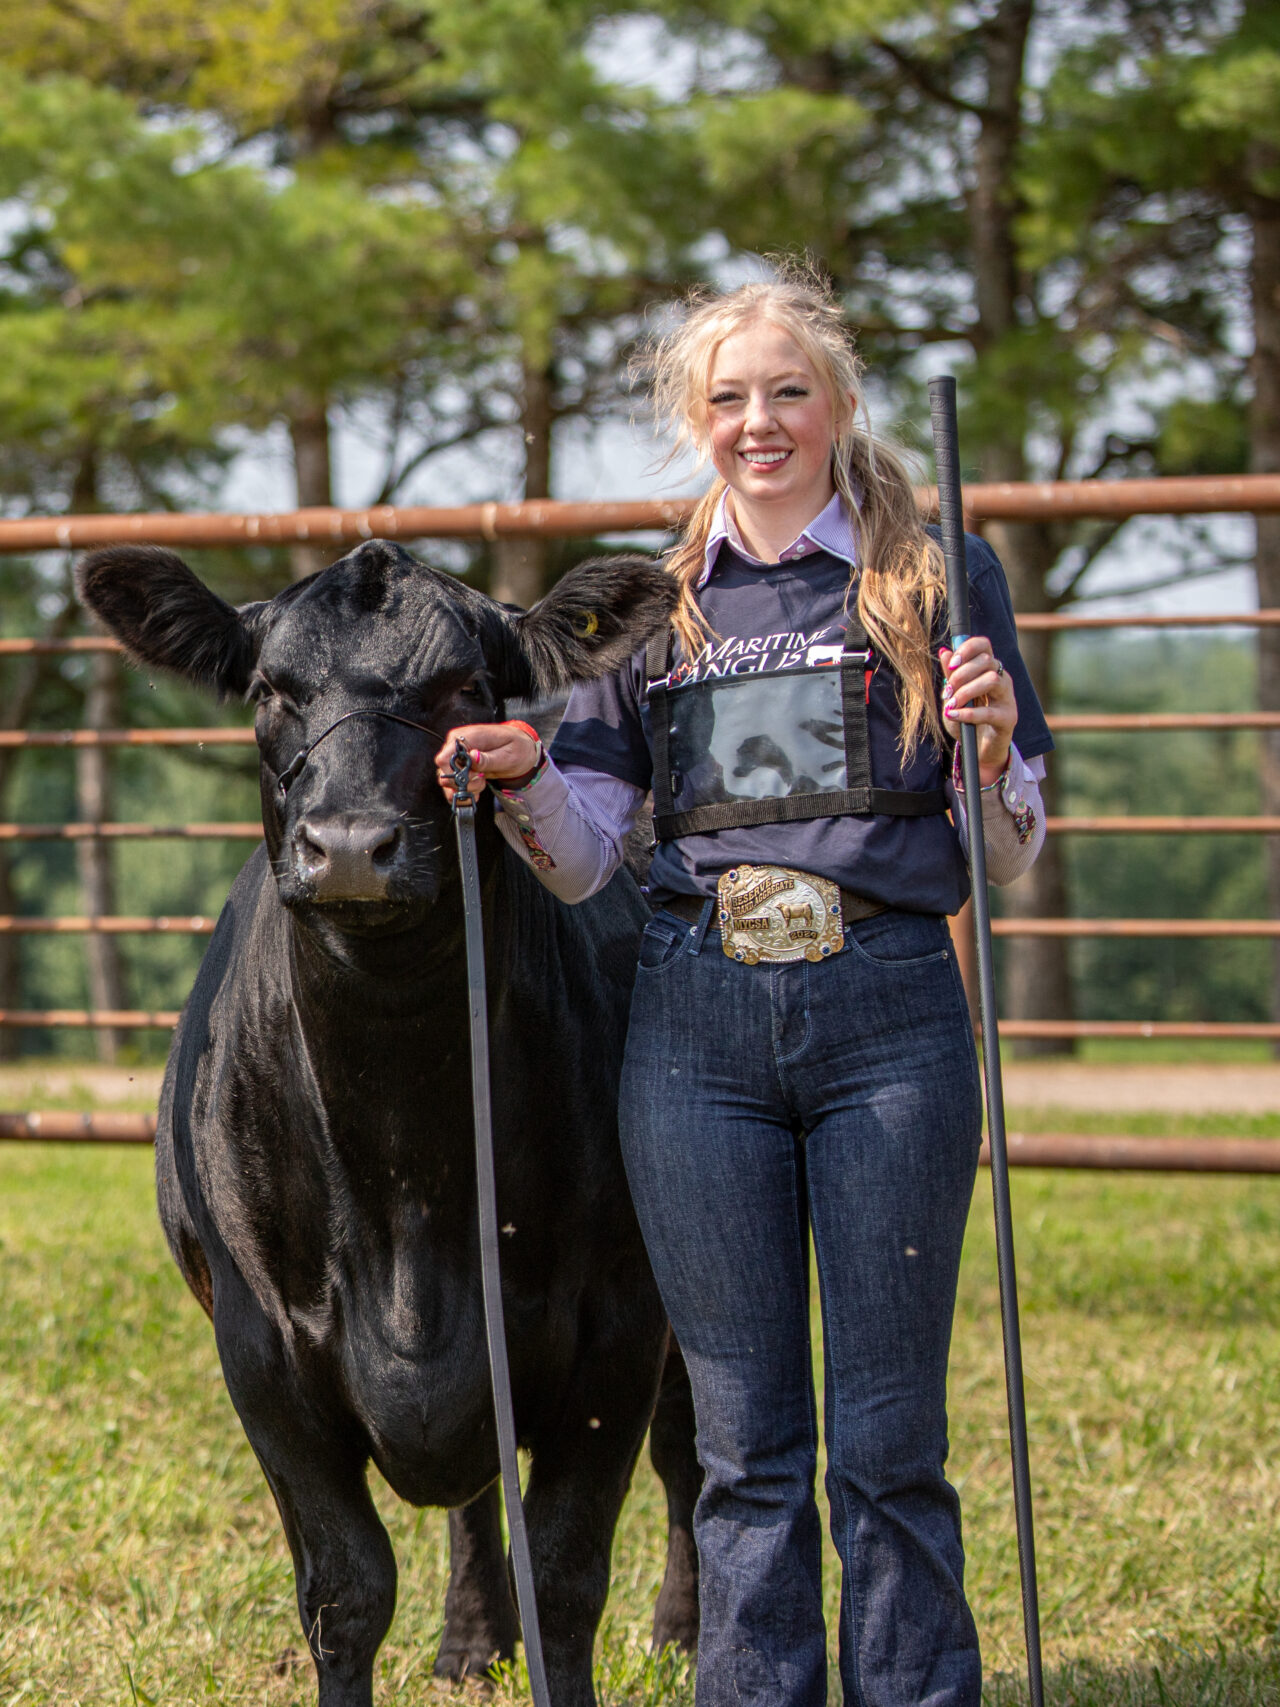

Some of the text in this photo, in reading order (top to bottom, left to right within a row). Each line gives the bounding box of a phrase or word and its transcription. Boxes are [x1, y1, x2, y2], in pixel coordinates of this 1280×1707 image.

[692, 626, 832, 665] MARITIME
[680, 646, 807, 687] ANGUS
[732, 878, 771, 906] RESERVE
[755, 879, 794, 905] AGGREGATE
[733, 918, 769, 930] MYCSA
